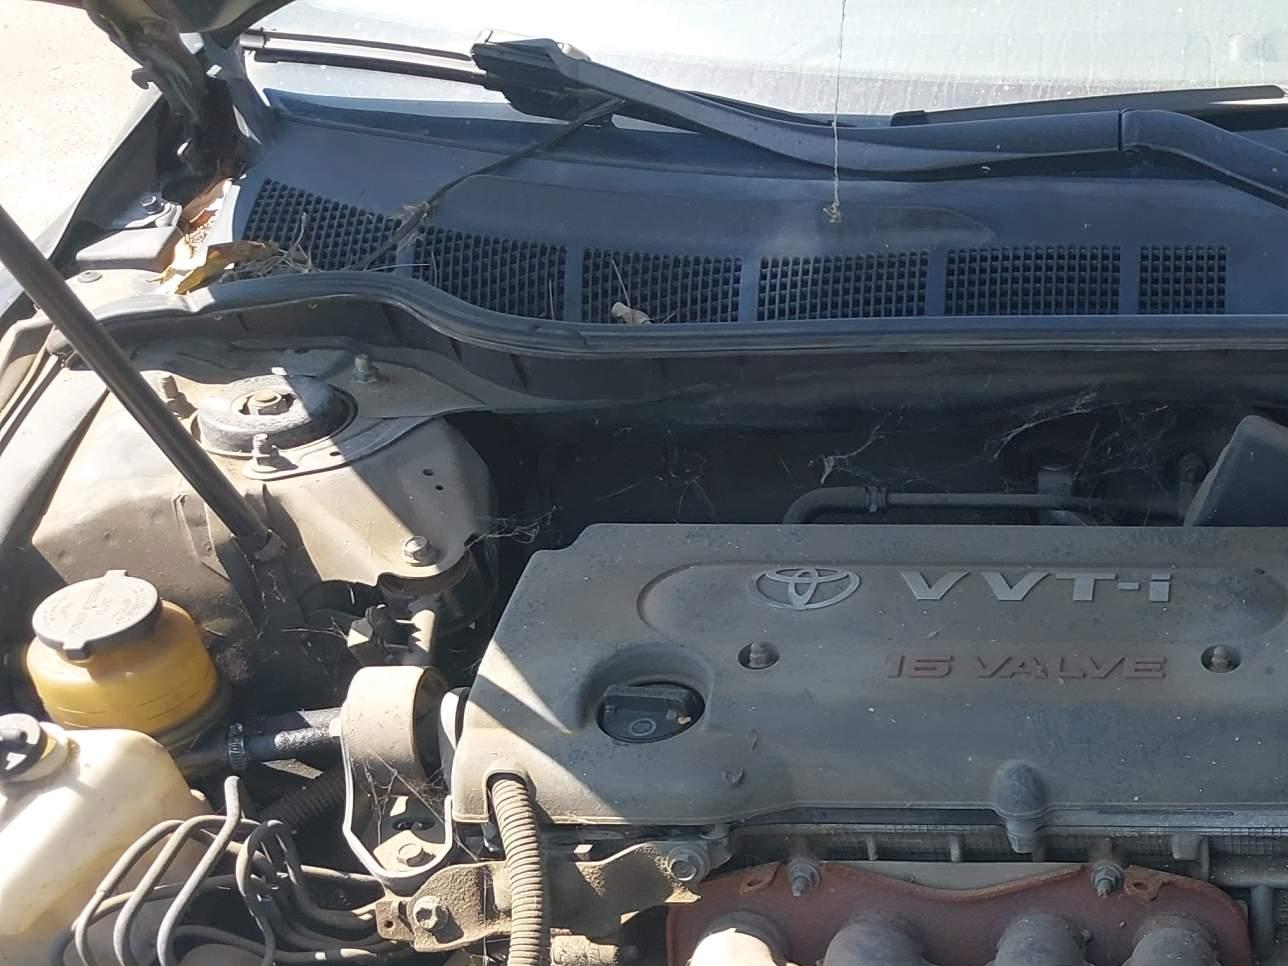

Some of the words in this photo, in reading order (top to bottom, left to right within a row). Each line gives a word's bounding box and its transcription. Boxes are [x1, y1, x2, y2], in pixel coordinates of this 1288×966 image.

[901, 571, 1171, 602] VVT-i
[886, 655, 955, 679] 16
[976, 655, 1168, 680] VALVE
